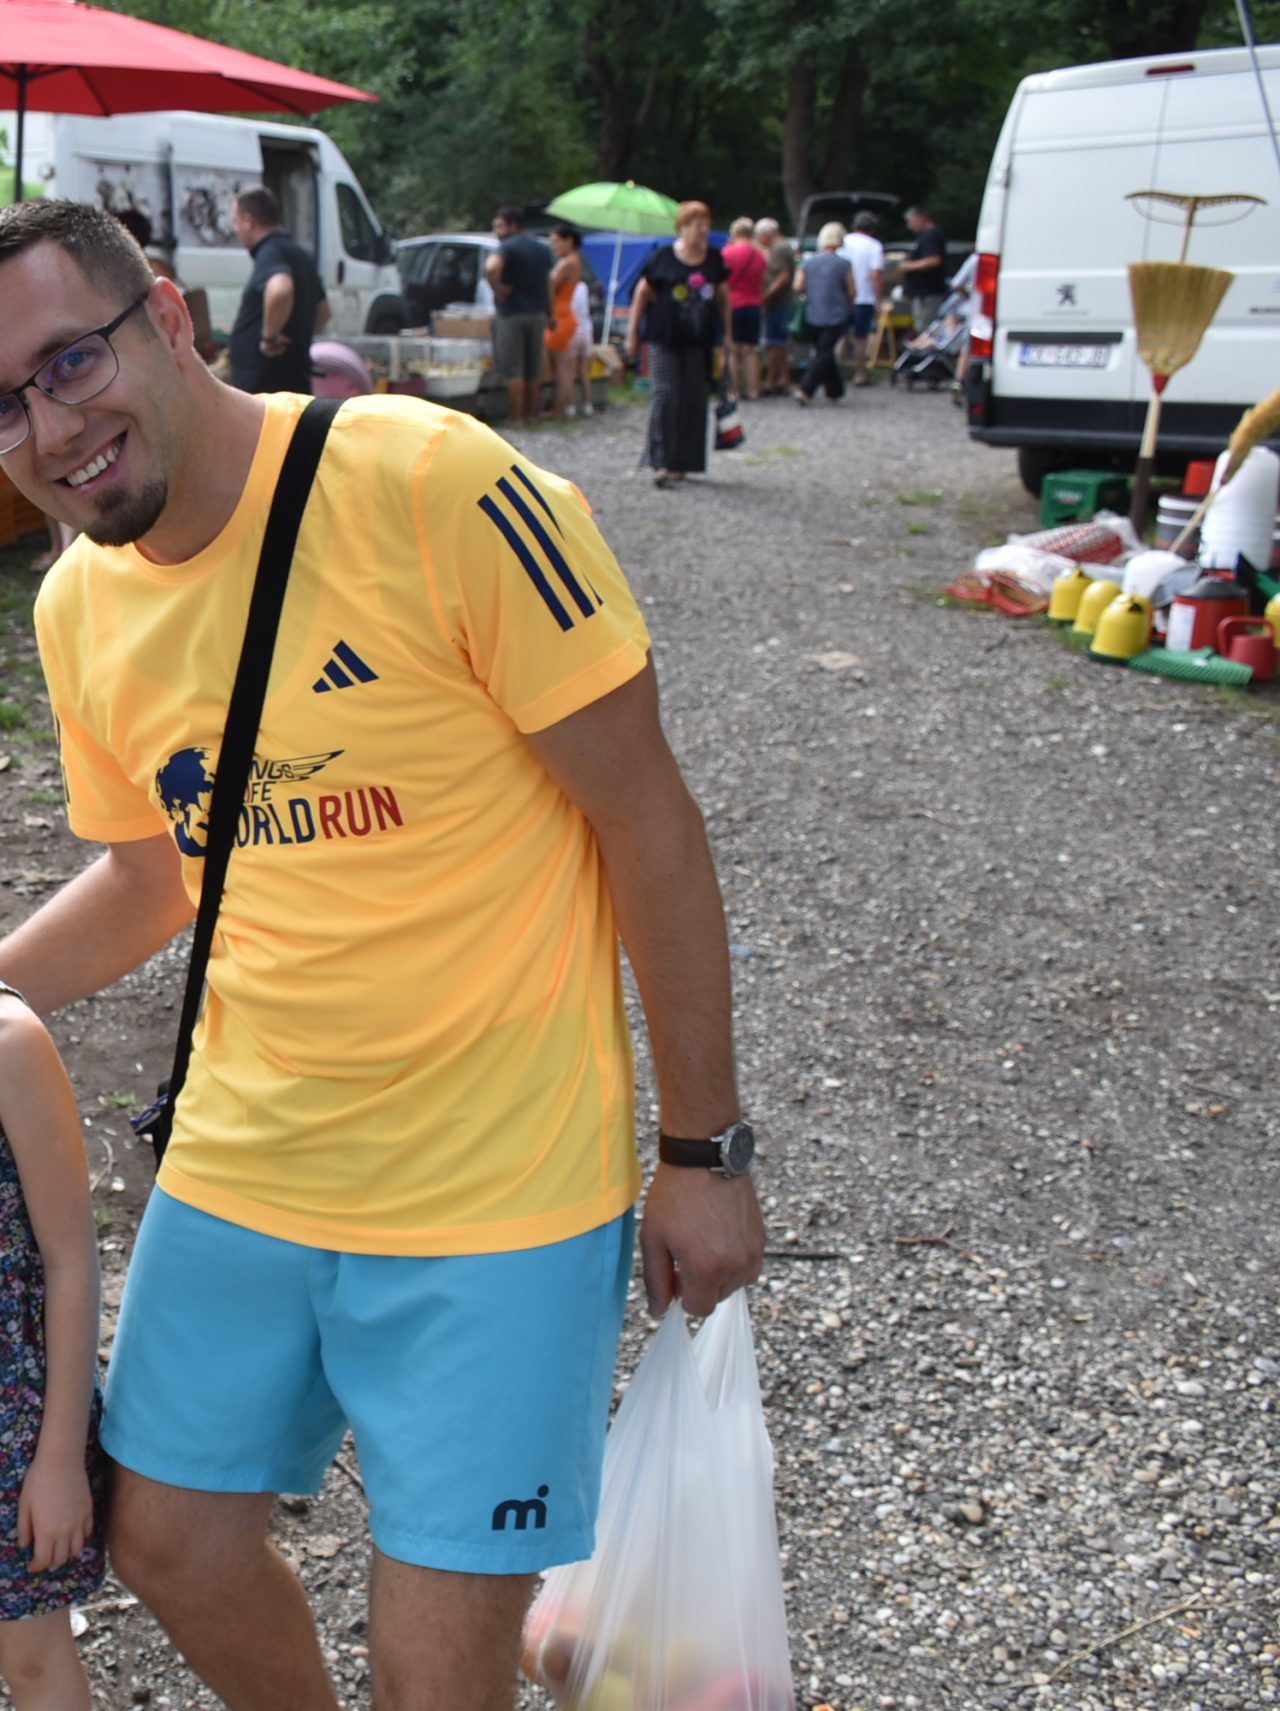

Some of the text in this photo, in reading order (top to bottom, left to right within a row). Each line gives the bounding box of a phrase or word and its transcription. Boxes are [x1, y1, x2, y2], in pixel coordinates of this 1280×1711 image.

[250, 760, 295, 780] NGS
[236, 786, 404, 848] ORLD RUN
